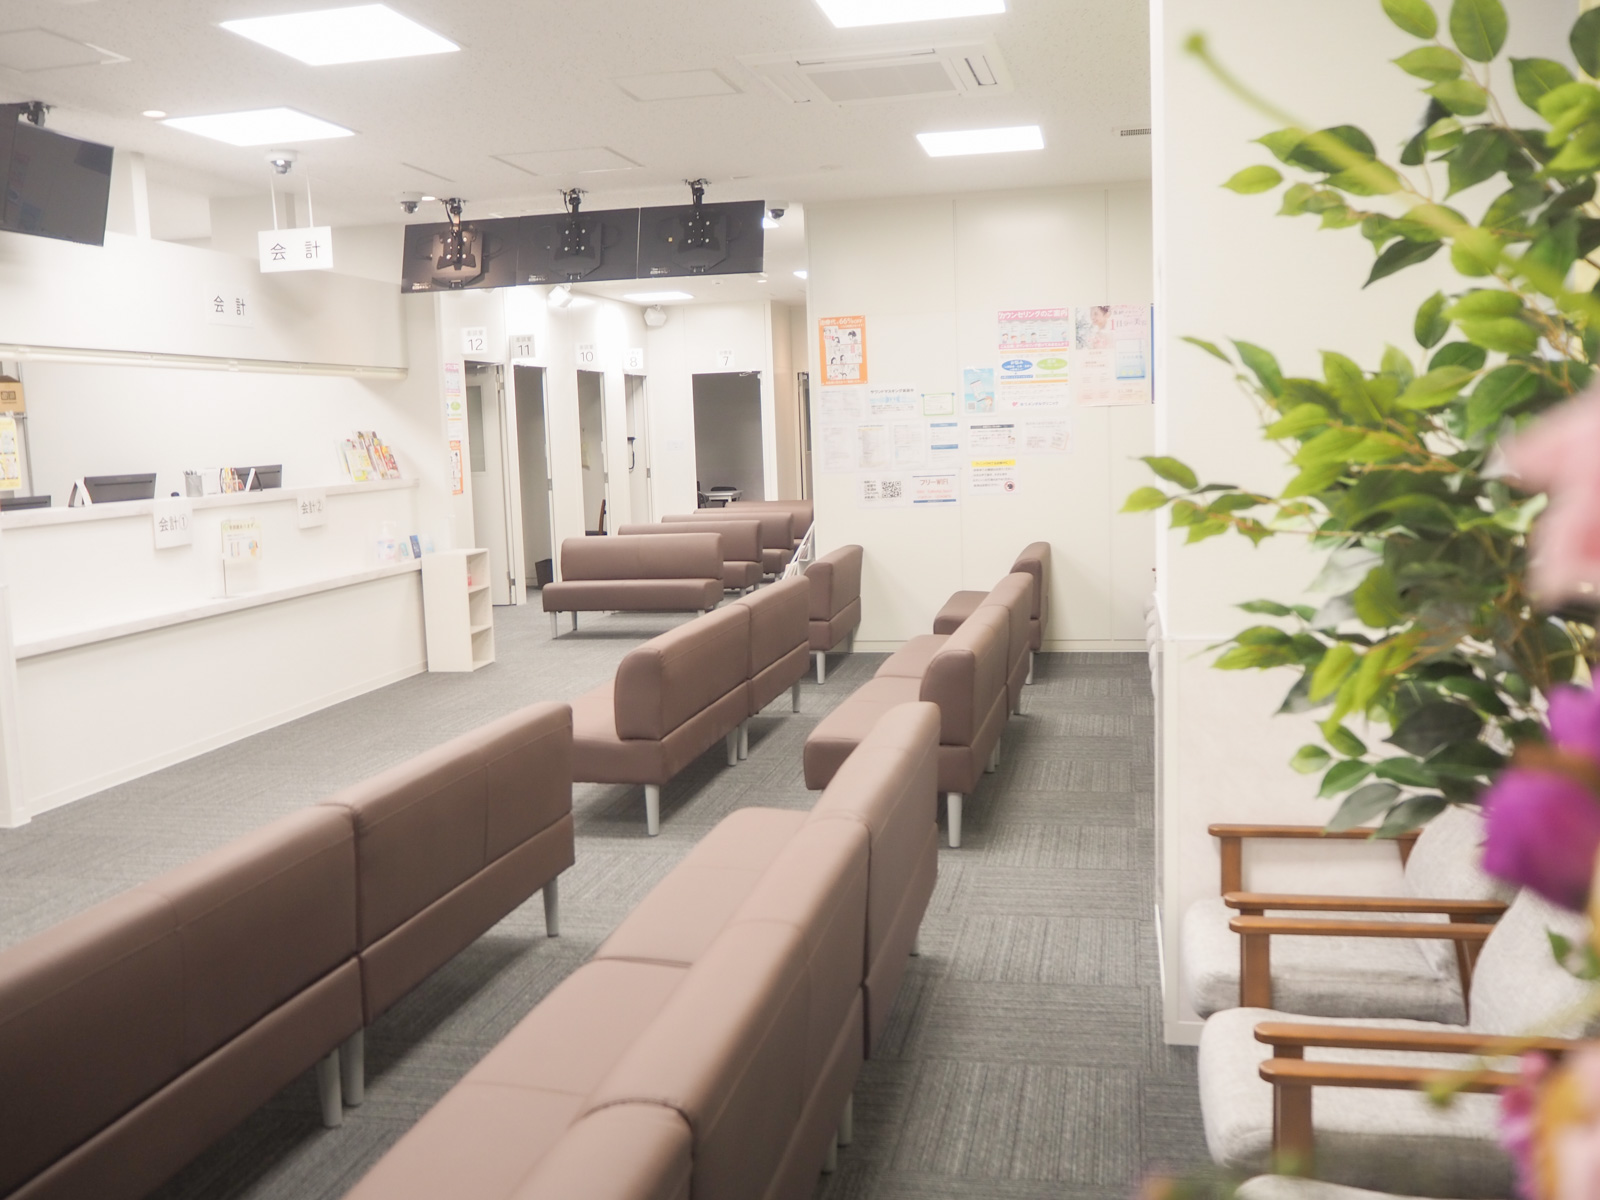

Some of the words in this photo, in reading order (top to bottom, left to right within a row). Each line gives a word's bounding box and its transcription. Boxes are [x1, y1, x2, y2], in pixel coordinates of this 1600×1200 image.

[270, 240, 321, 261] 会計
[213, 295, 246, 317] 会計
[467, 337, 484, 351] 12
[518, 344, 530, 356] 11
[580, 351, 594, 362] 10
[629, 356, 638, 368] 8
[722, 356, 730, 367] 7
